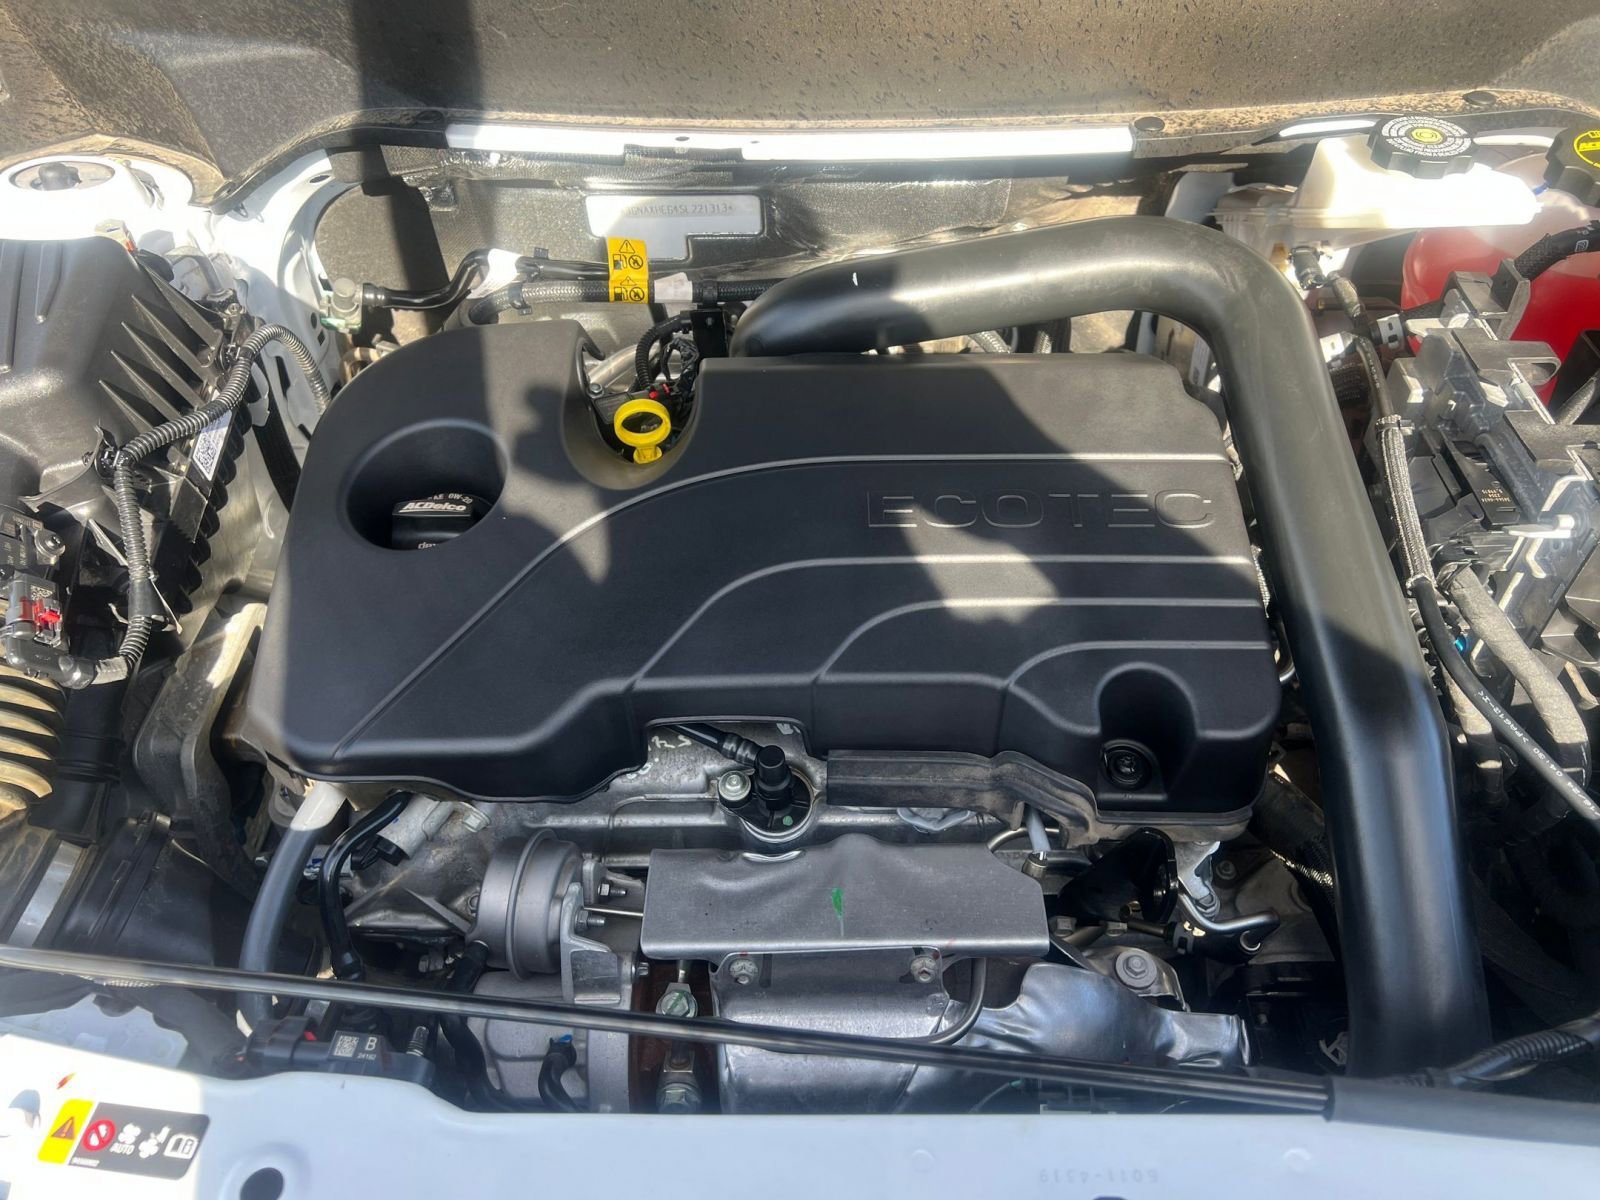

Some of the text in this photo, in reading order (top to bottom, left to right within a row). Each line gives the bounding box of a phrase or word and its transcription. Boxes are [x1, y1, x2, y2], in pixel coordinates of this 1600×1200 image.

[448, 493, 473, 504] 0W-20
[402, 501, 467, 511] ACDelco
[867, 489, 1215, 529] ECOTEC
[365, 1036, 378, 1051] B
[109, 1142, 135, 1155] AUTO
